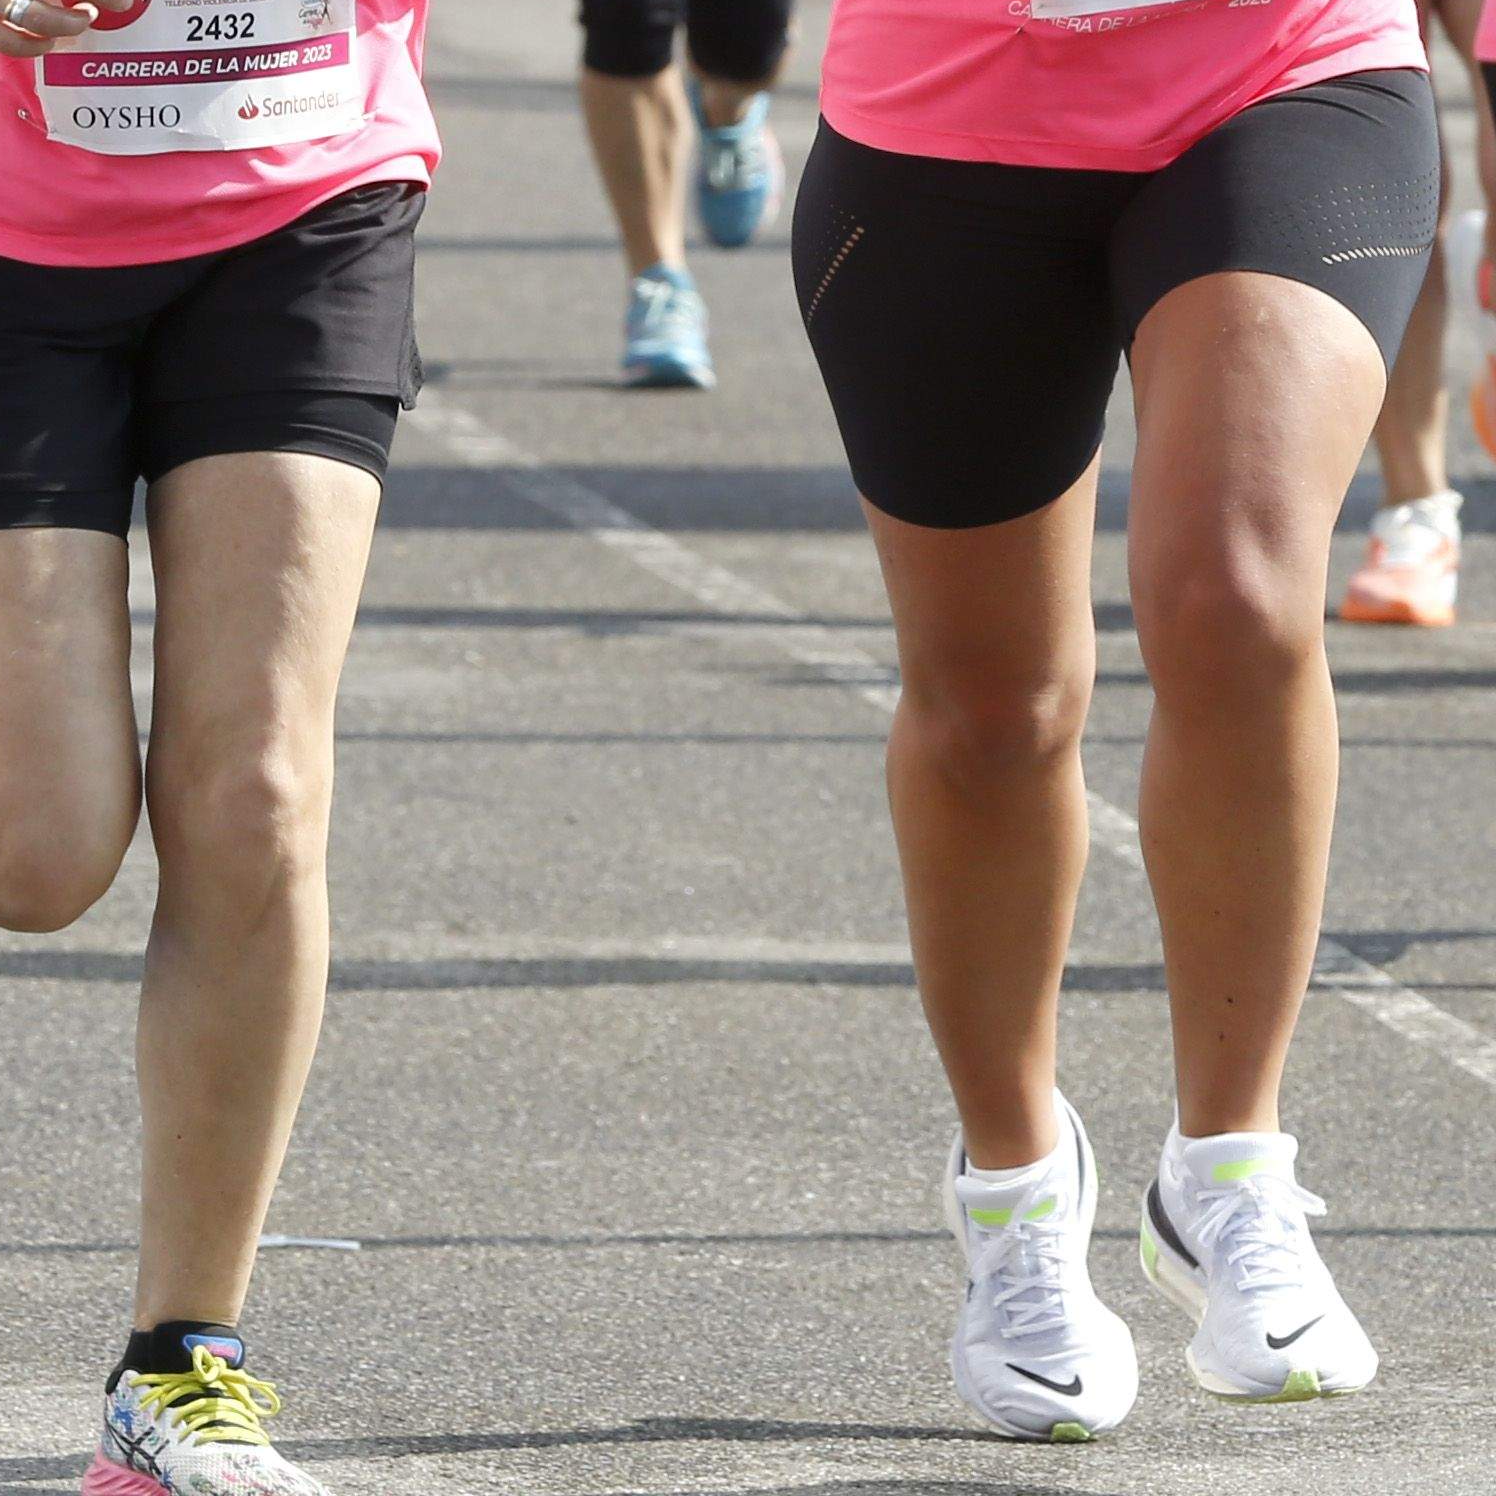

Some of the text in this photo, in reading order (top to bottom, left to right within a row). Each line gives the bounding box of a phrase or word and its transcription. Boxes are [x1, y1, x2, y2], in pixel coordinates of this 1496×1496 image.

[186, 12, 255, 42] 2432
[81, 43, 332, 78] CARRERA DE LA MUJER 2023
[72, 91, 340, 129] OYSHO Santander
